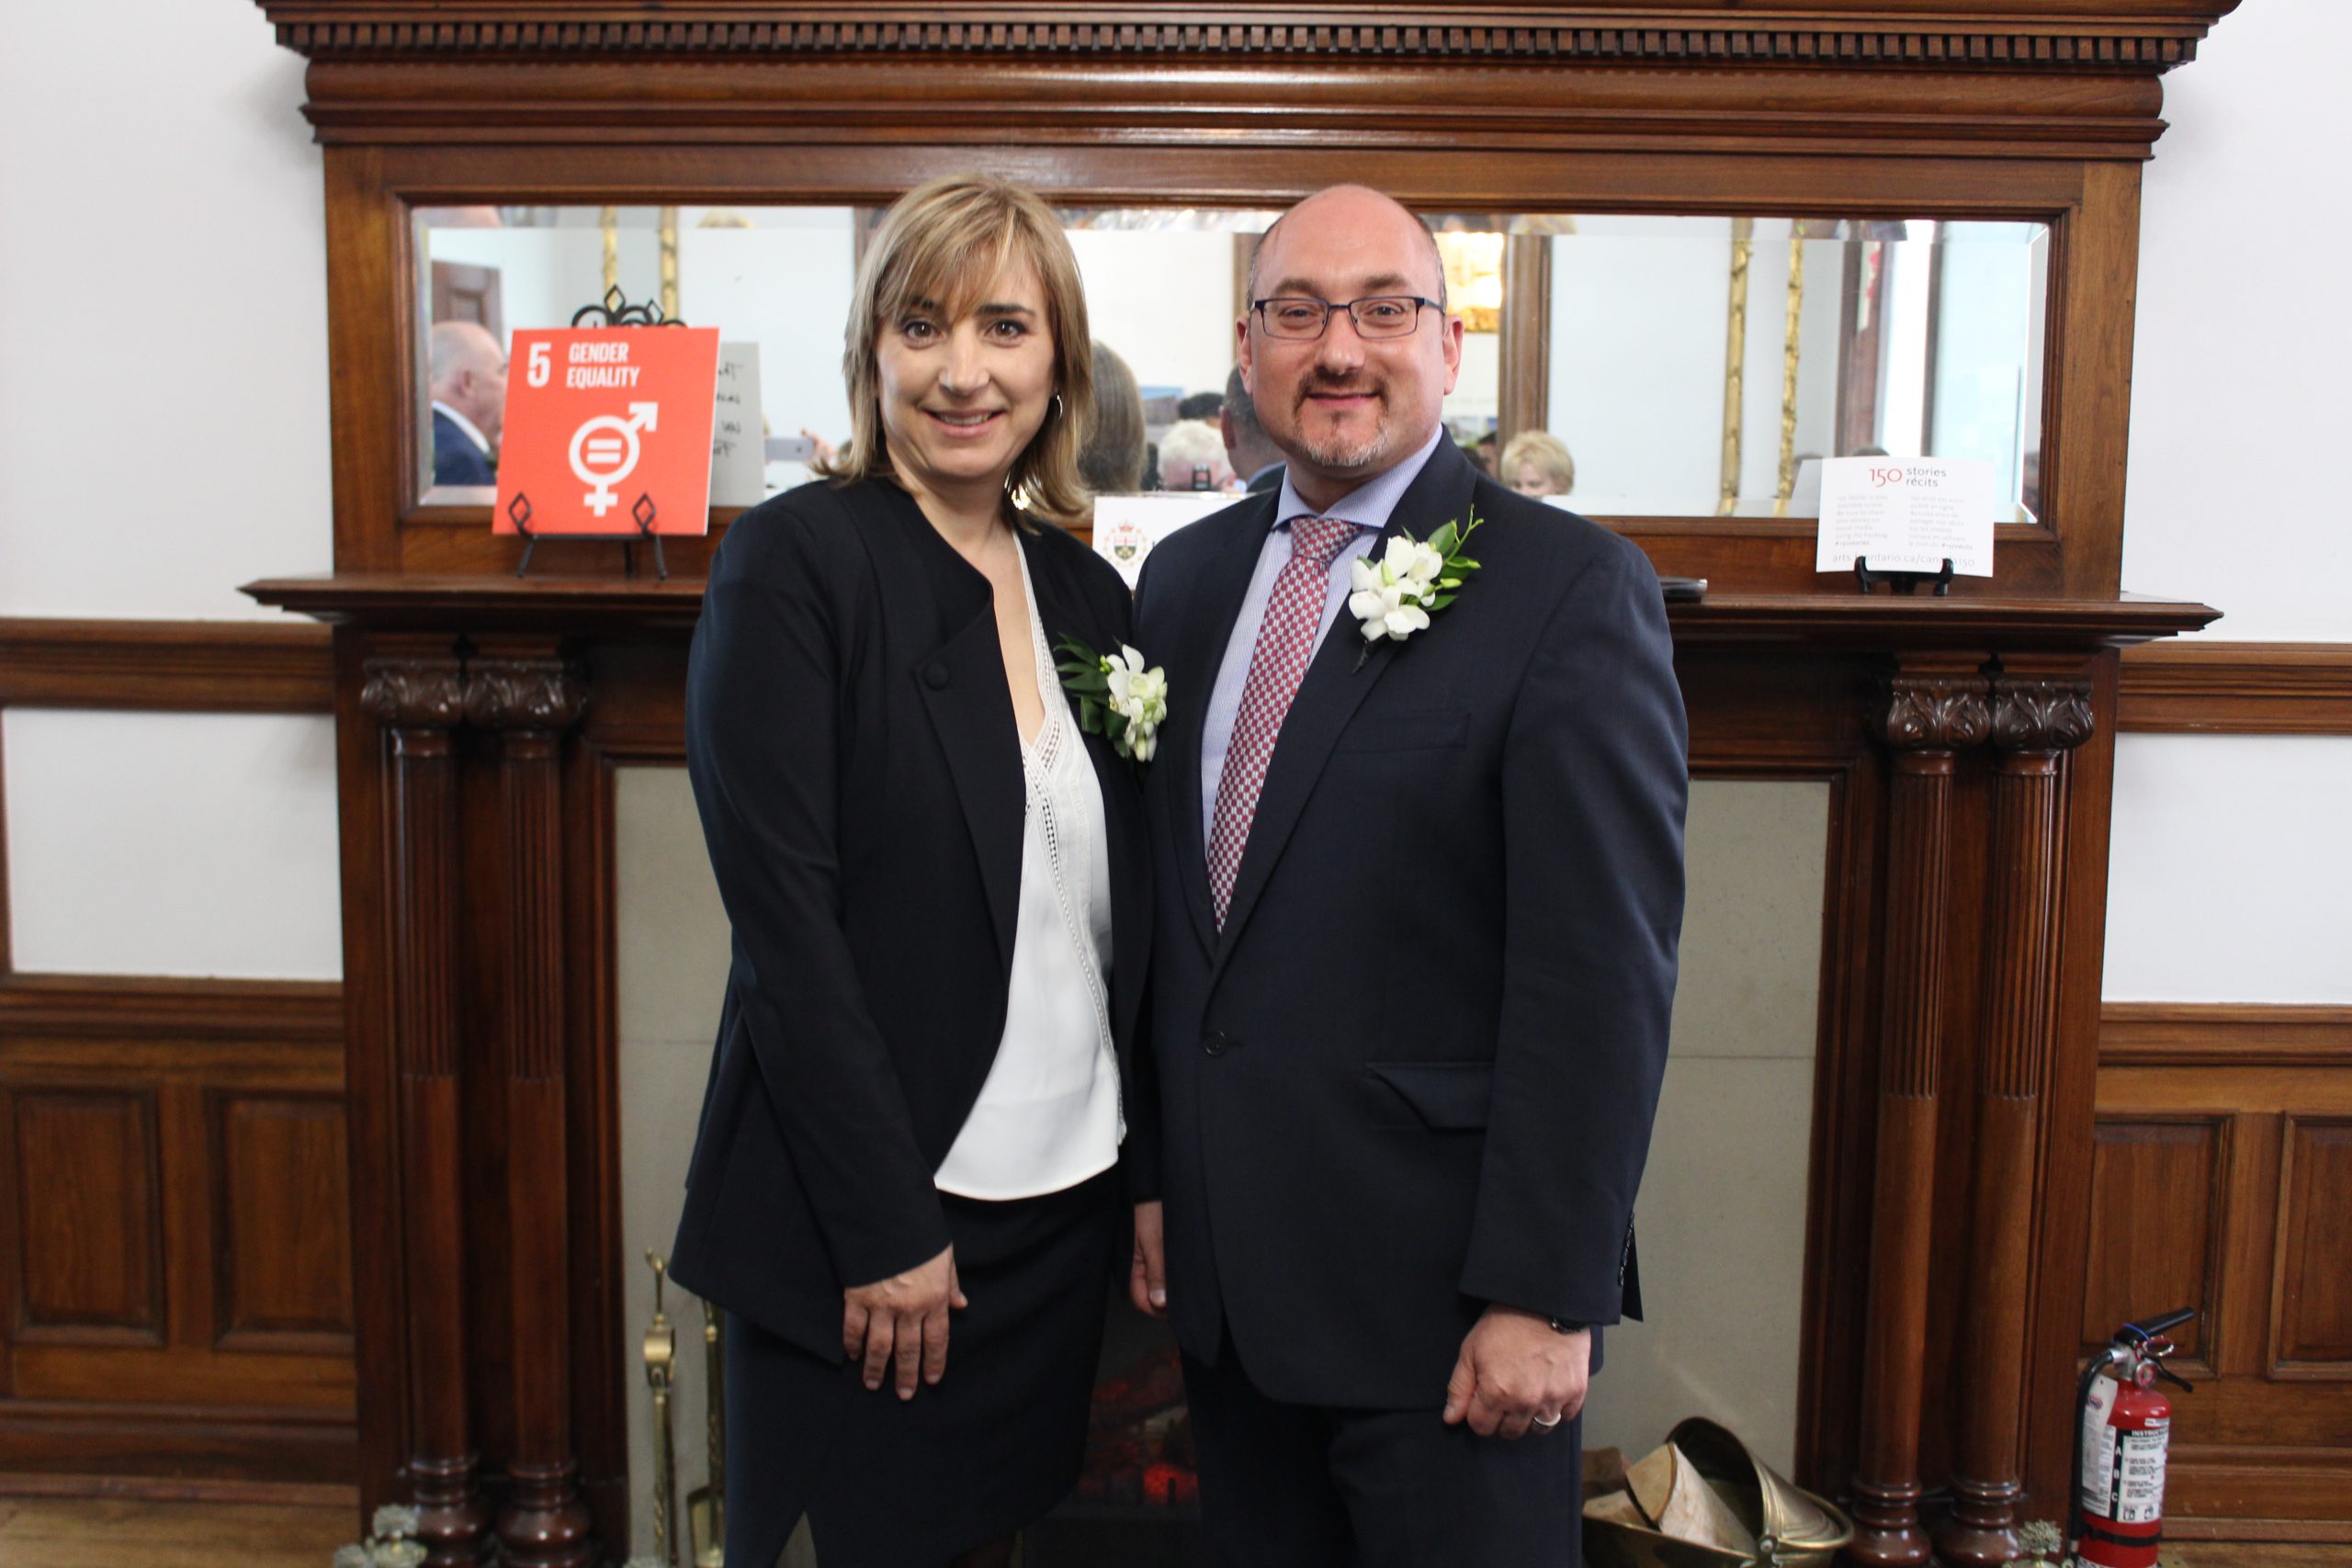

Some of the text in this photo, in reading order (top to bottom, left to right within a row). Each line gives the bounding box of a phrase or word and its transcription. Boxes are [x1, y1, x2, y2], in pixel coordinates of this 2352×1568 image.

[569, 342, 629, 363] GENDER
[527, 342, 551, 387] 5
[566, 366, 640, 389] EQUALITY
[1869, 467, 1947, 488] 150 stories
[1905, 476, 1939, 488] récits
[2115, 1446, 2122, 1457] A
[2113, 1468, 2120, 1480] B
[2111, 1490, 2119, 1503] C
